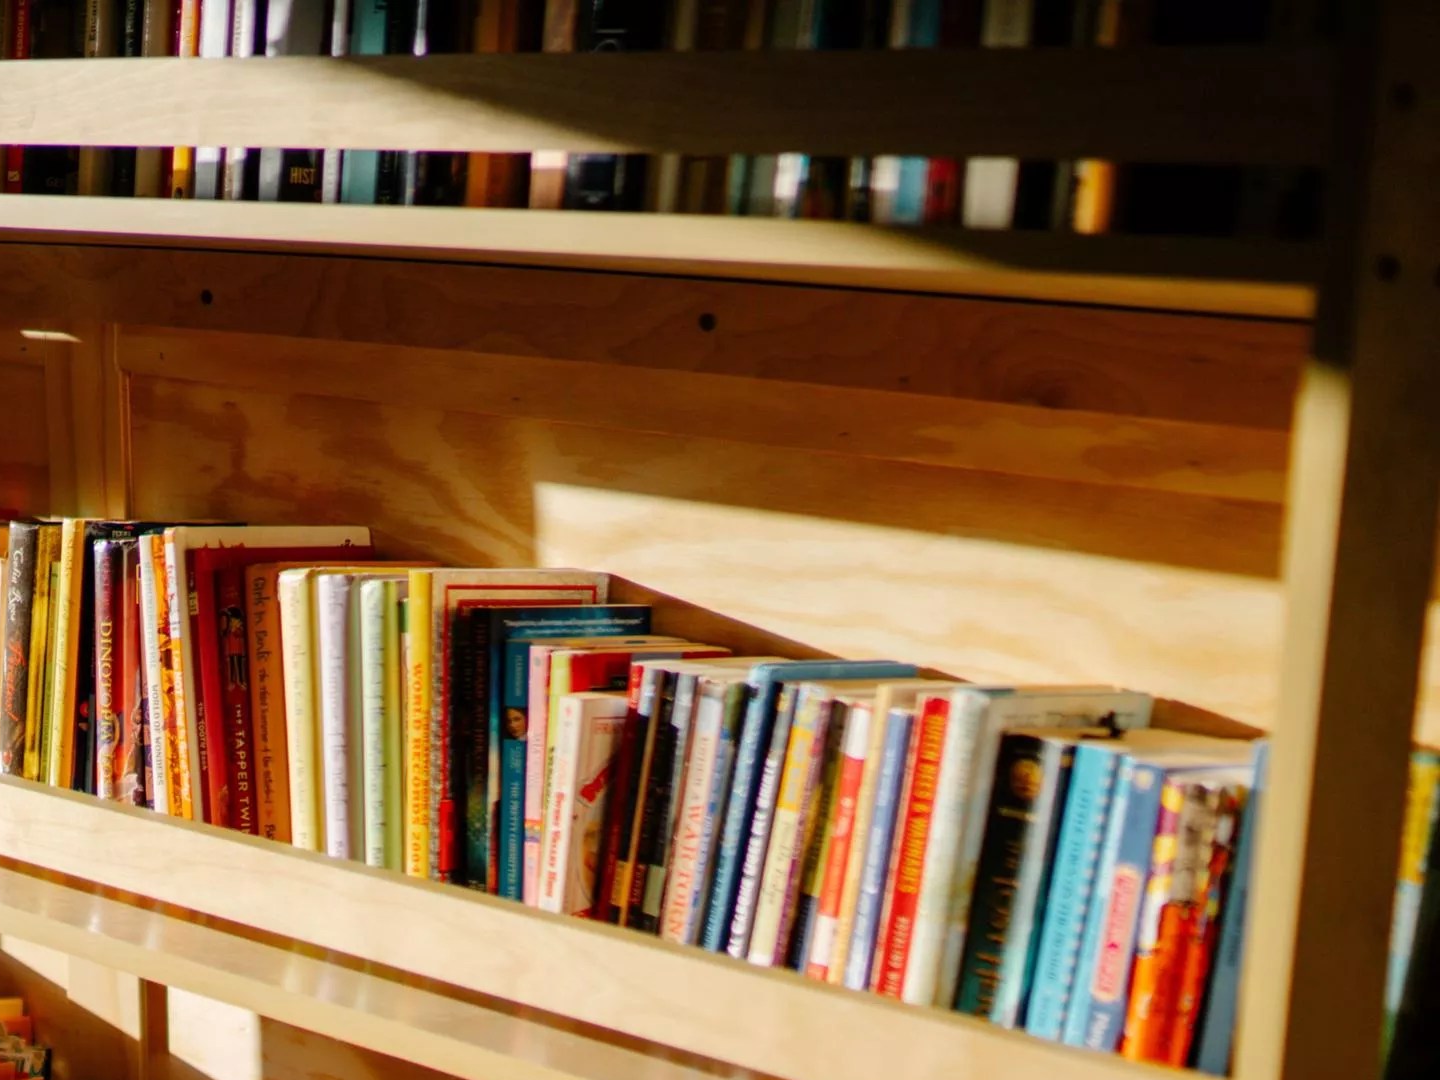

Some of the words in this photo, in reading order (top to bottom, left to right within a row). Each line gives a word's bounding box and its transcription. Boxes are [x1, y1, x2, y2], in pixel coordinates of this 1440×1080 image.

[97, 619, 112, 742] DINOTOPIA
[149, 684, 159, 718] WORLD
[412, 664, 421, 731] WORLD
[153, 736, 163, 786] WONDERS
[234, 729, 247, 792] TAPPER
[410, 742, 422, 826] RECORDS
